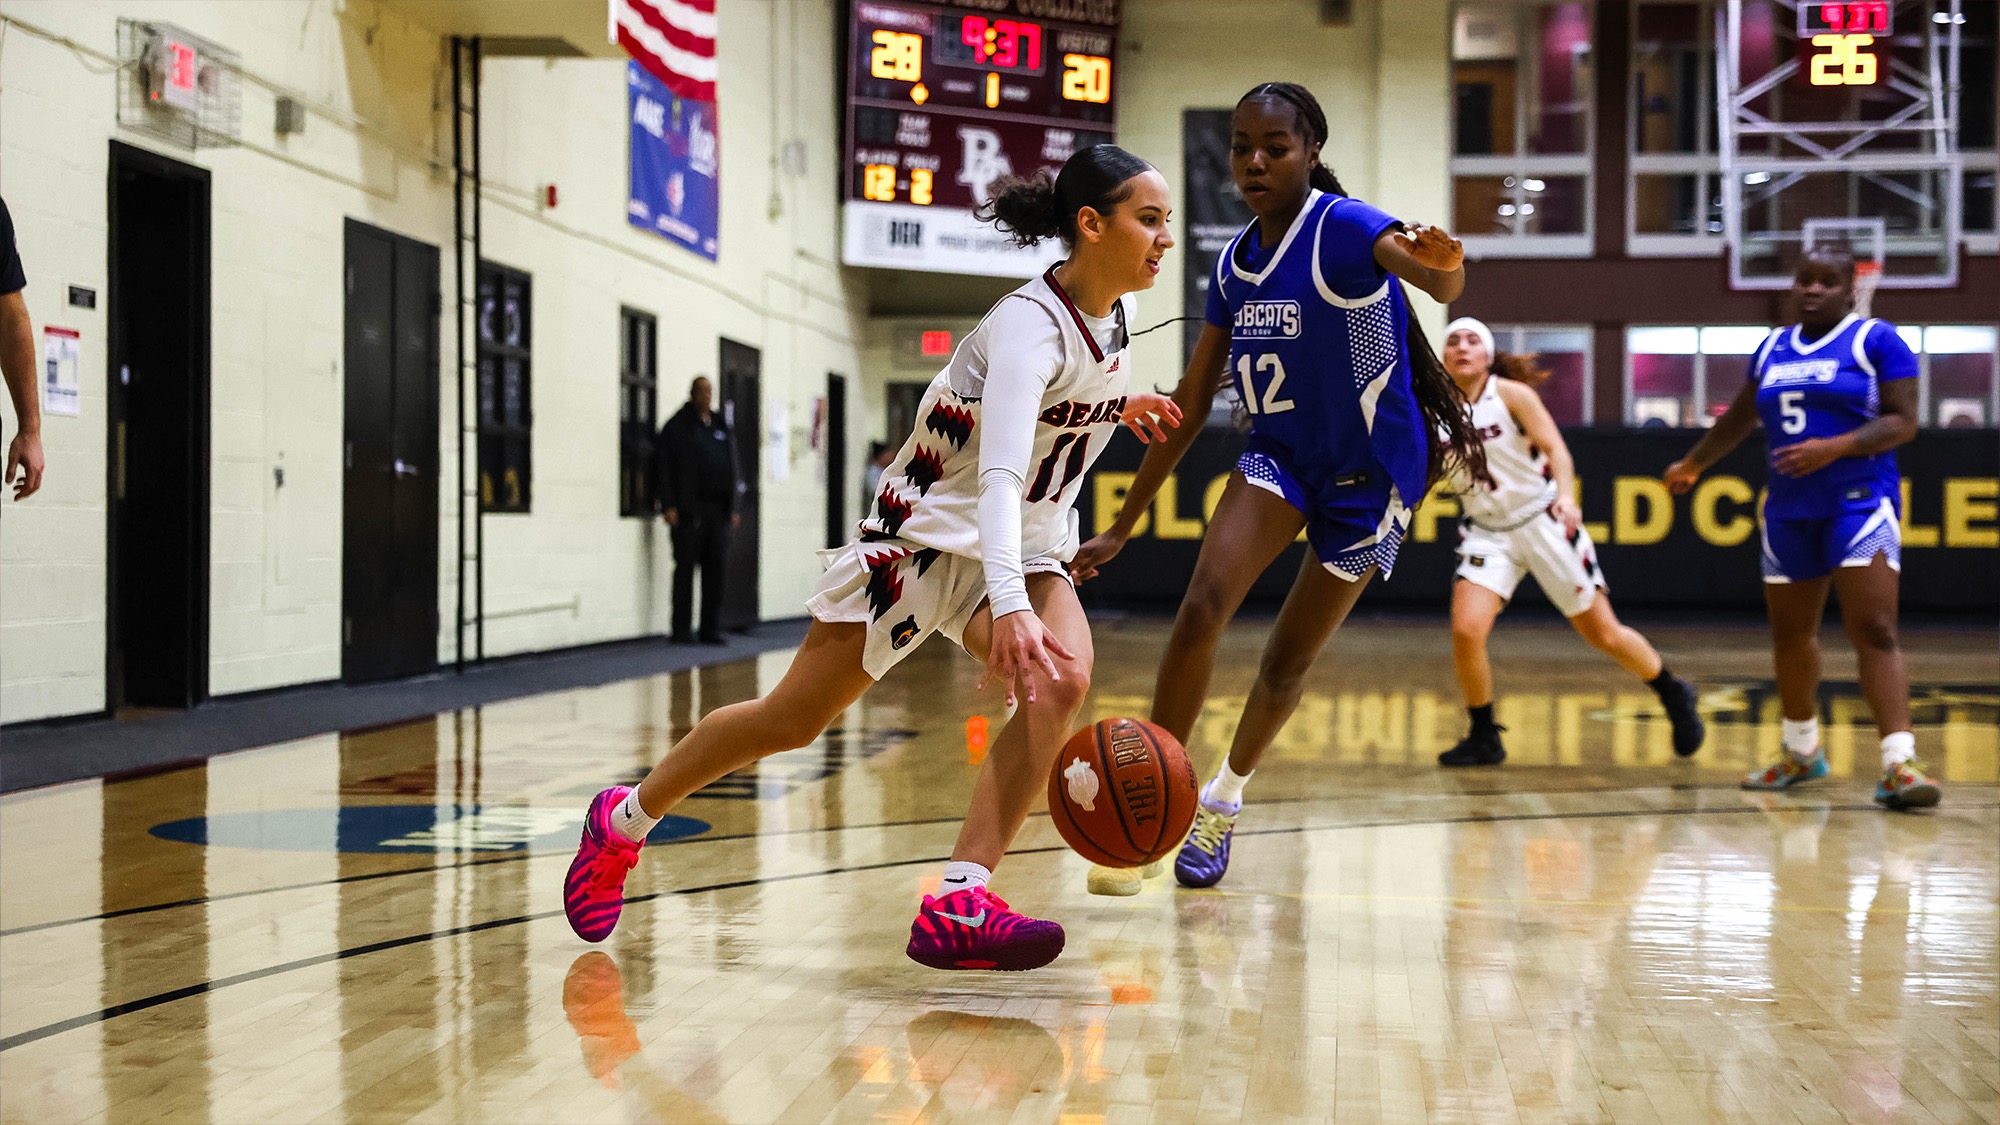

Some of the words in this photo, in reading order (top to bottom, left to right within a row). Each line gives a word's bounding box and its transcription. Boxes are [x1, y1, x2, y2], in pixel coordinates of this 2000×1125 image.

[871, 30, 922, 82] 28
[962, 16, 1041, 70] 9:37
[1810, 34, 1877, 85] 26
[986, 72, 999, 108] 1
[1062, 54, 1111, 104] 20
[910, 168, 933, 206] 2
[1237, 353, 1295, 415] 12
[1779, 391, 1807, 435] 5
[1026, 432, 1091, 503] 11
[1110, 722, 1149, 769] ROCK
[1122, 775, 1157, 827] THE
